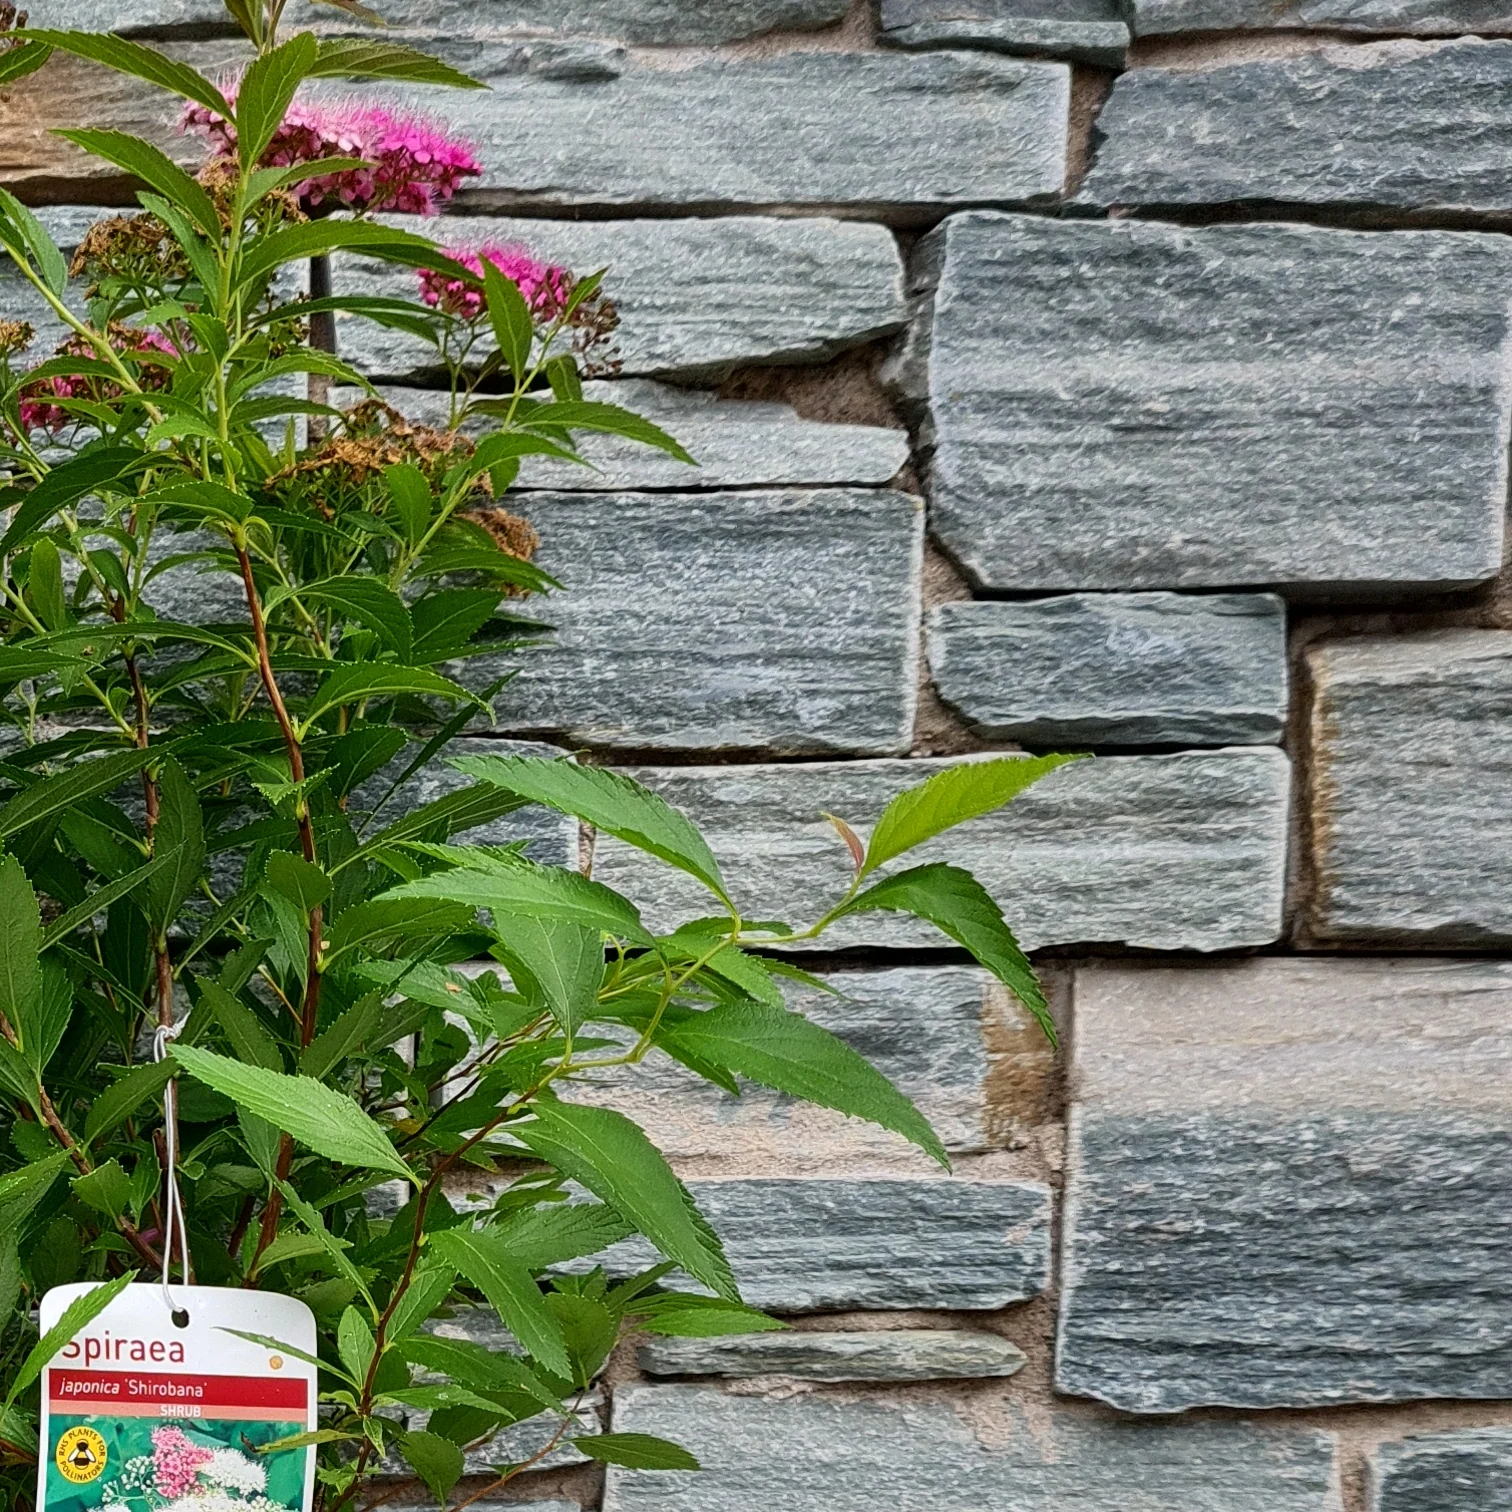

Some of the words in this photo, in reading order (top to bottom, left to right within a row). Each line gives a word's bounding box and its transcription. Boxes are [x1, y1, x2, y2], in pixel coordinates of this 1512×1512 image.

[59, 1378, 120, 1396] japonica
[160, 1404, 202, 1418] SHRUB
[59, 1439, 69, 1457] RHS
[68, 1428, 98, 1441] PLANTS
[96, 1440, 106, 1457] FOR
[59, 1460, 104, 1481] POLLINATORS
